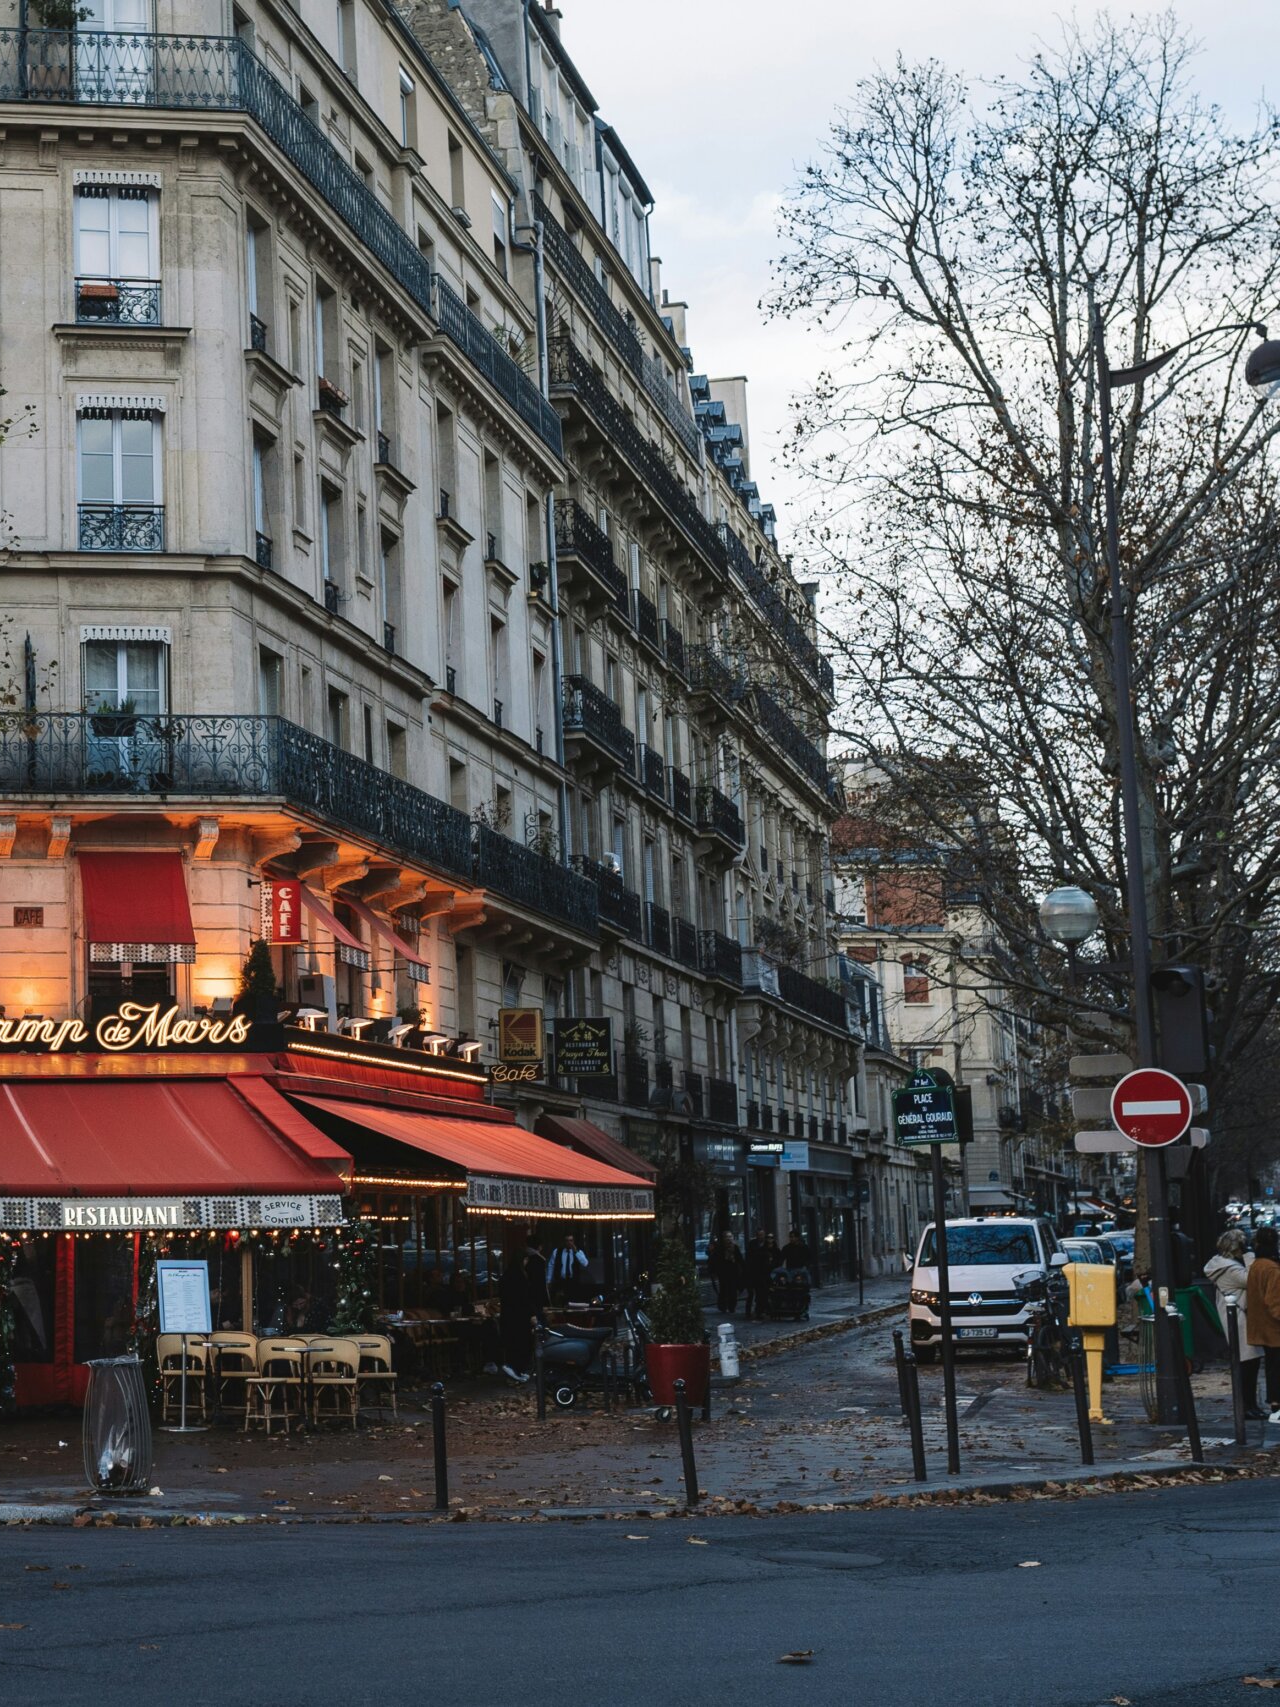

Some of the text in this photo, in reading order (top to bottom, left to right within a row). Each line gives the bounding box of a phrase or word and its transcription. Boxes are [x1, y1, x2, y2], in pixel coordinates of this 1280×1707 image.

[98, 1000, 252, 1051] Mars
[103, 1015, 131, 1043] de
[504, 1047, 536, 1057] Kodak
[491, 1064, 539, 1081] Café
[913, 1093, 933, 1104] PLACE
[898, 1111, 953, 1125] GÉNÉRAL GOURAUD
[264, 1201, 303, 1212] SERVICE
[64, 1205, 180, 1227] RESTAURANT
[264, 1214, 305, 1224] CONTINU
